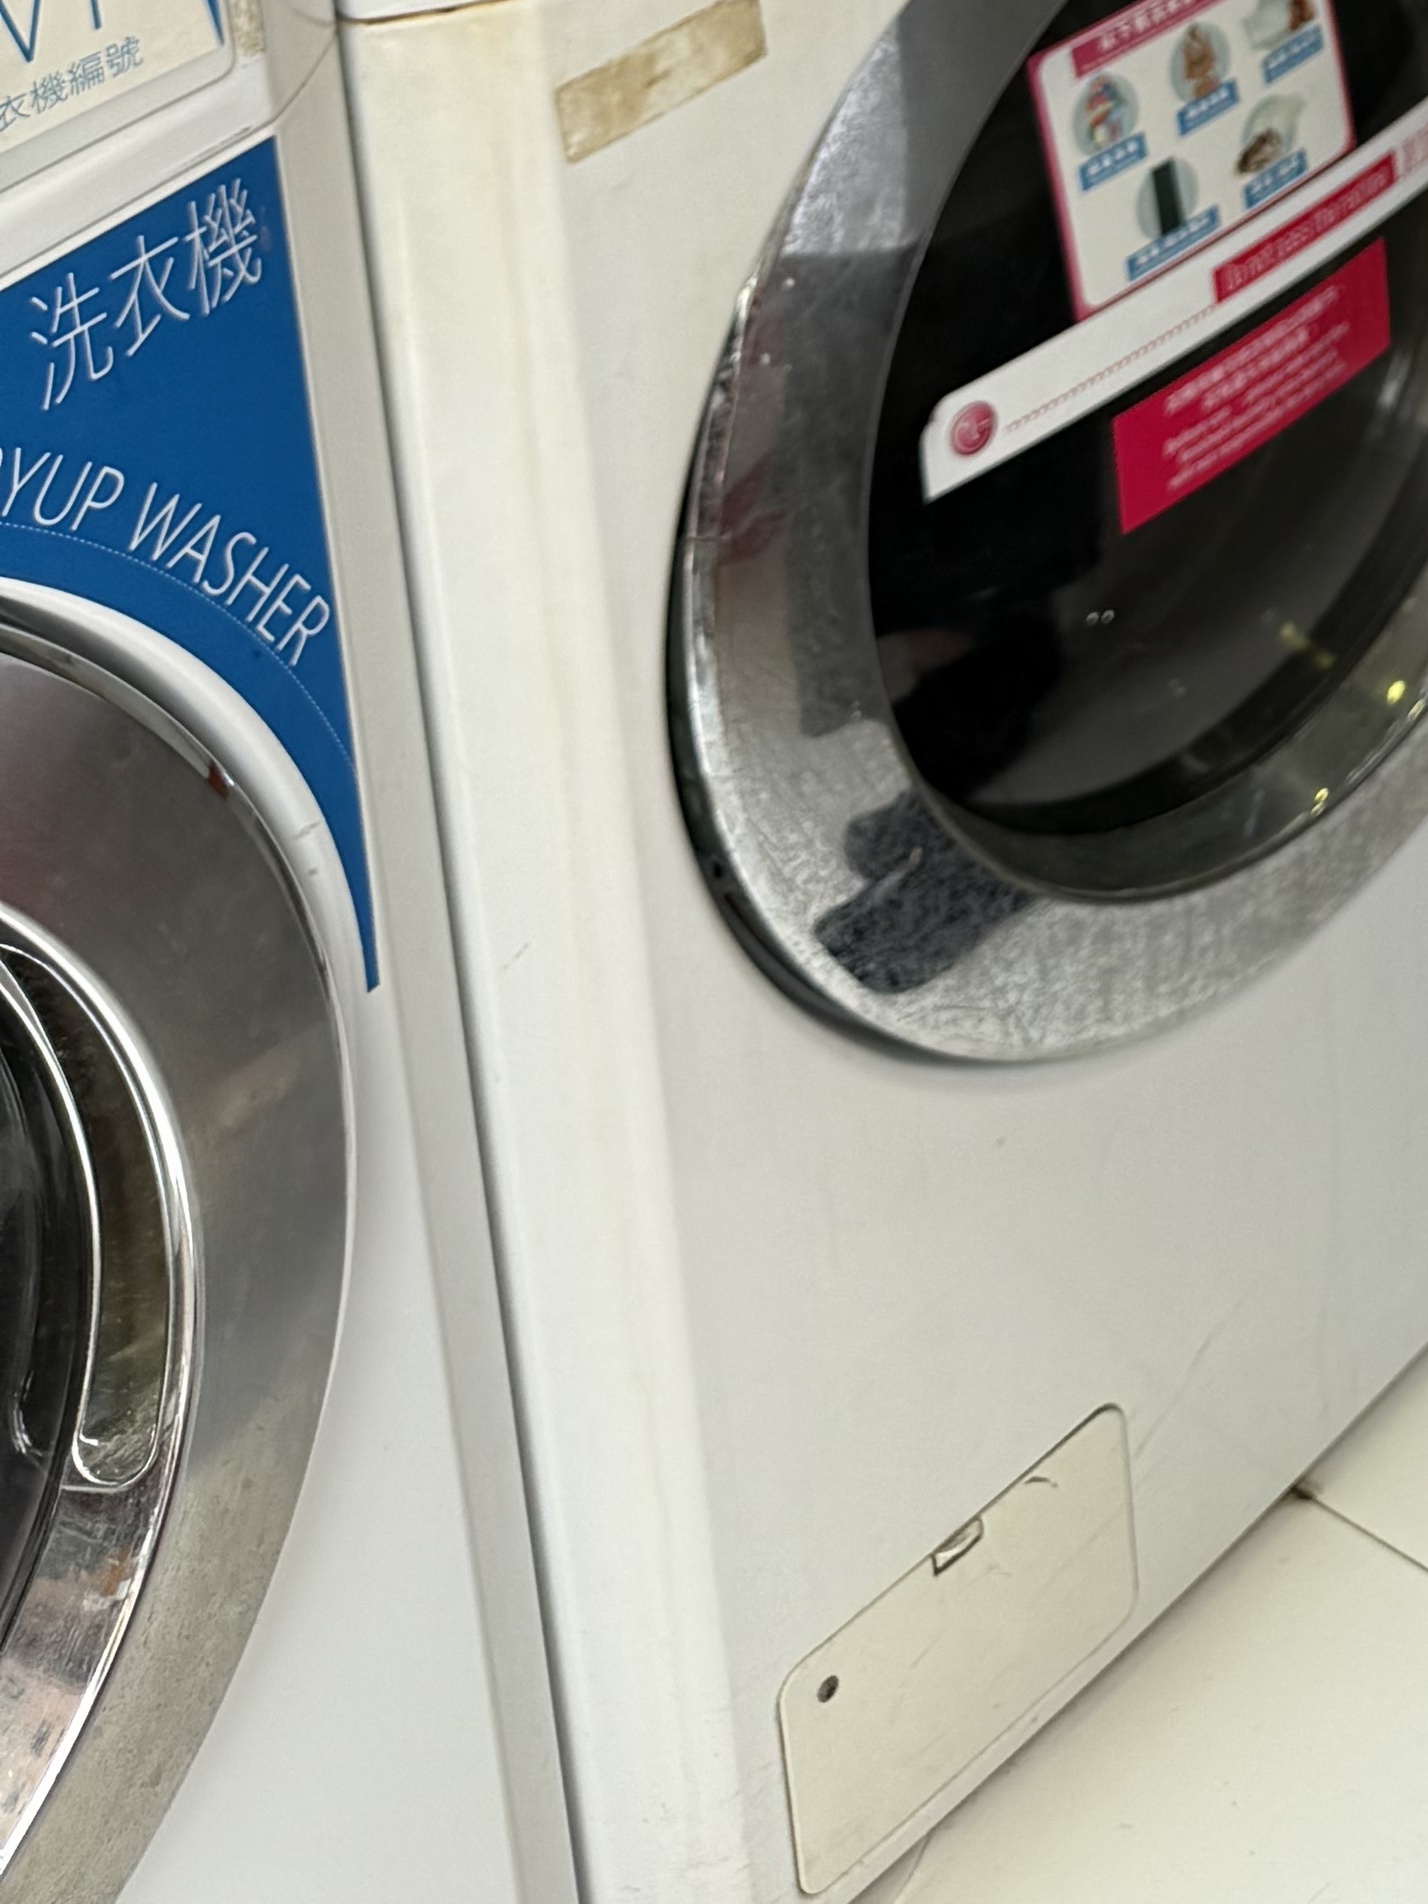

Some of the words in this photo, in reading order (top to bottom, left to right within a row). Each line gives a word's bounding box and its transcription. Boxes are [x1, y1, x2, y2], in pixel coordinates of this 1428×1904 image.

[0, 36, 145, 133] 衣機編號
[30, 177, 263, 412] 洗衣機
[0, 444, 125, 535] YUP
[128, 481, 332, 669] WASHER
